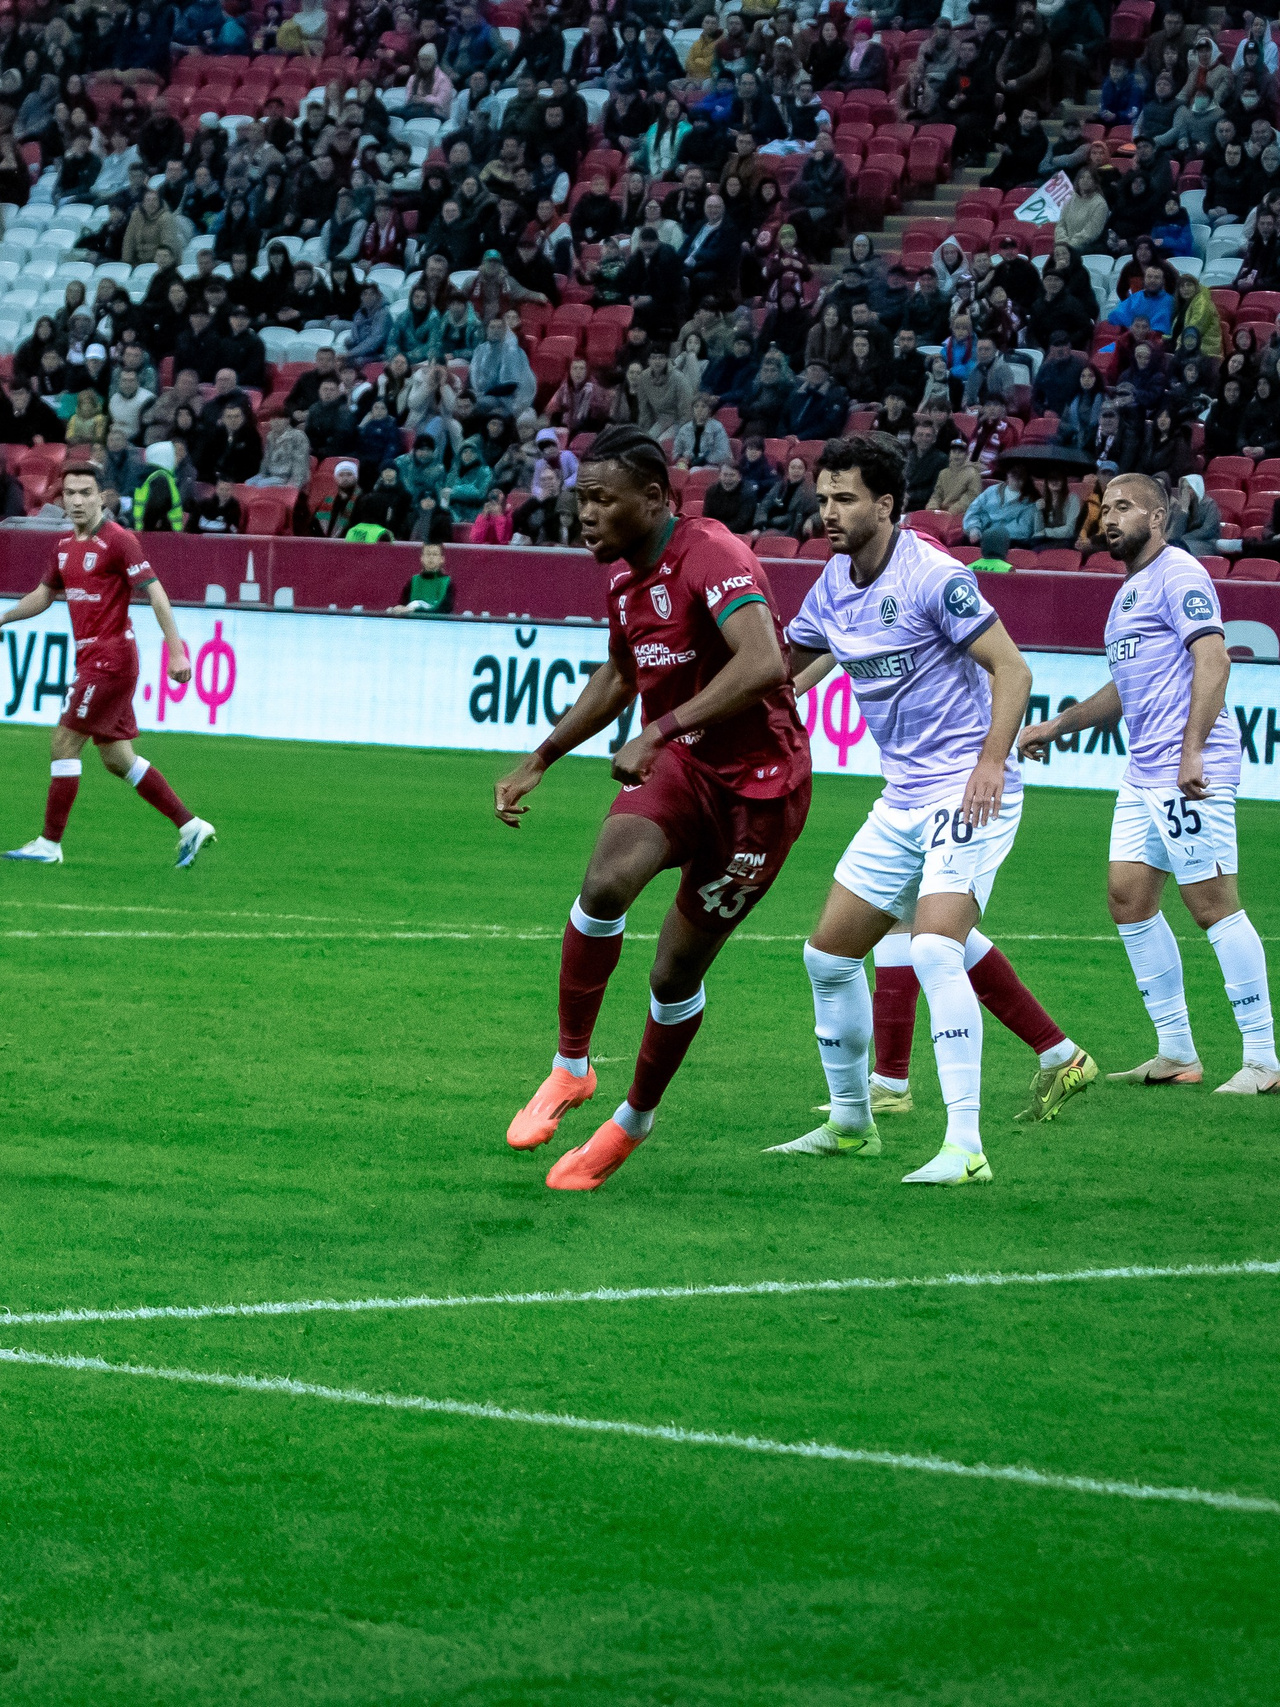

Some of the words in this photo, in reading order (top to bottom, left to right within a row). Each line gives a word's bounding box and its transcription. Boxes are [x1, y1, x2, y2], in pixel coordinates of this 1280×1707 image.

[931, 808, 974, 849] 26
[1163, 797, 1202, 839] 35
[697, 874, 760, 919] 43
